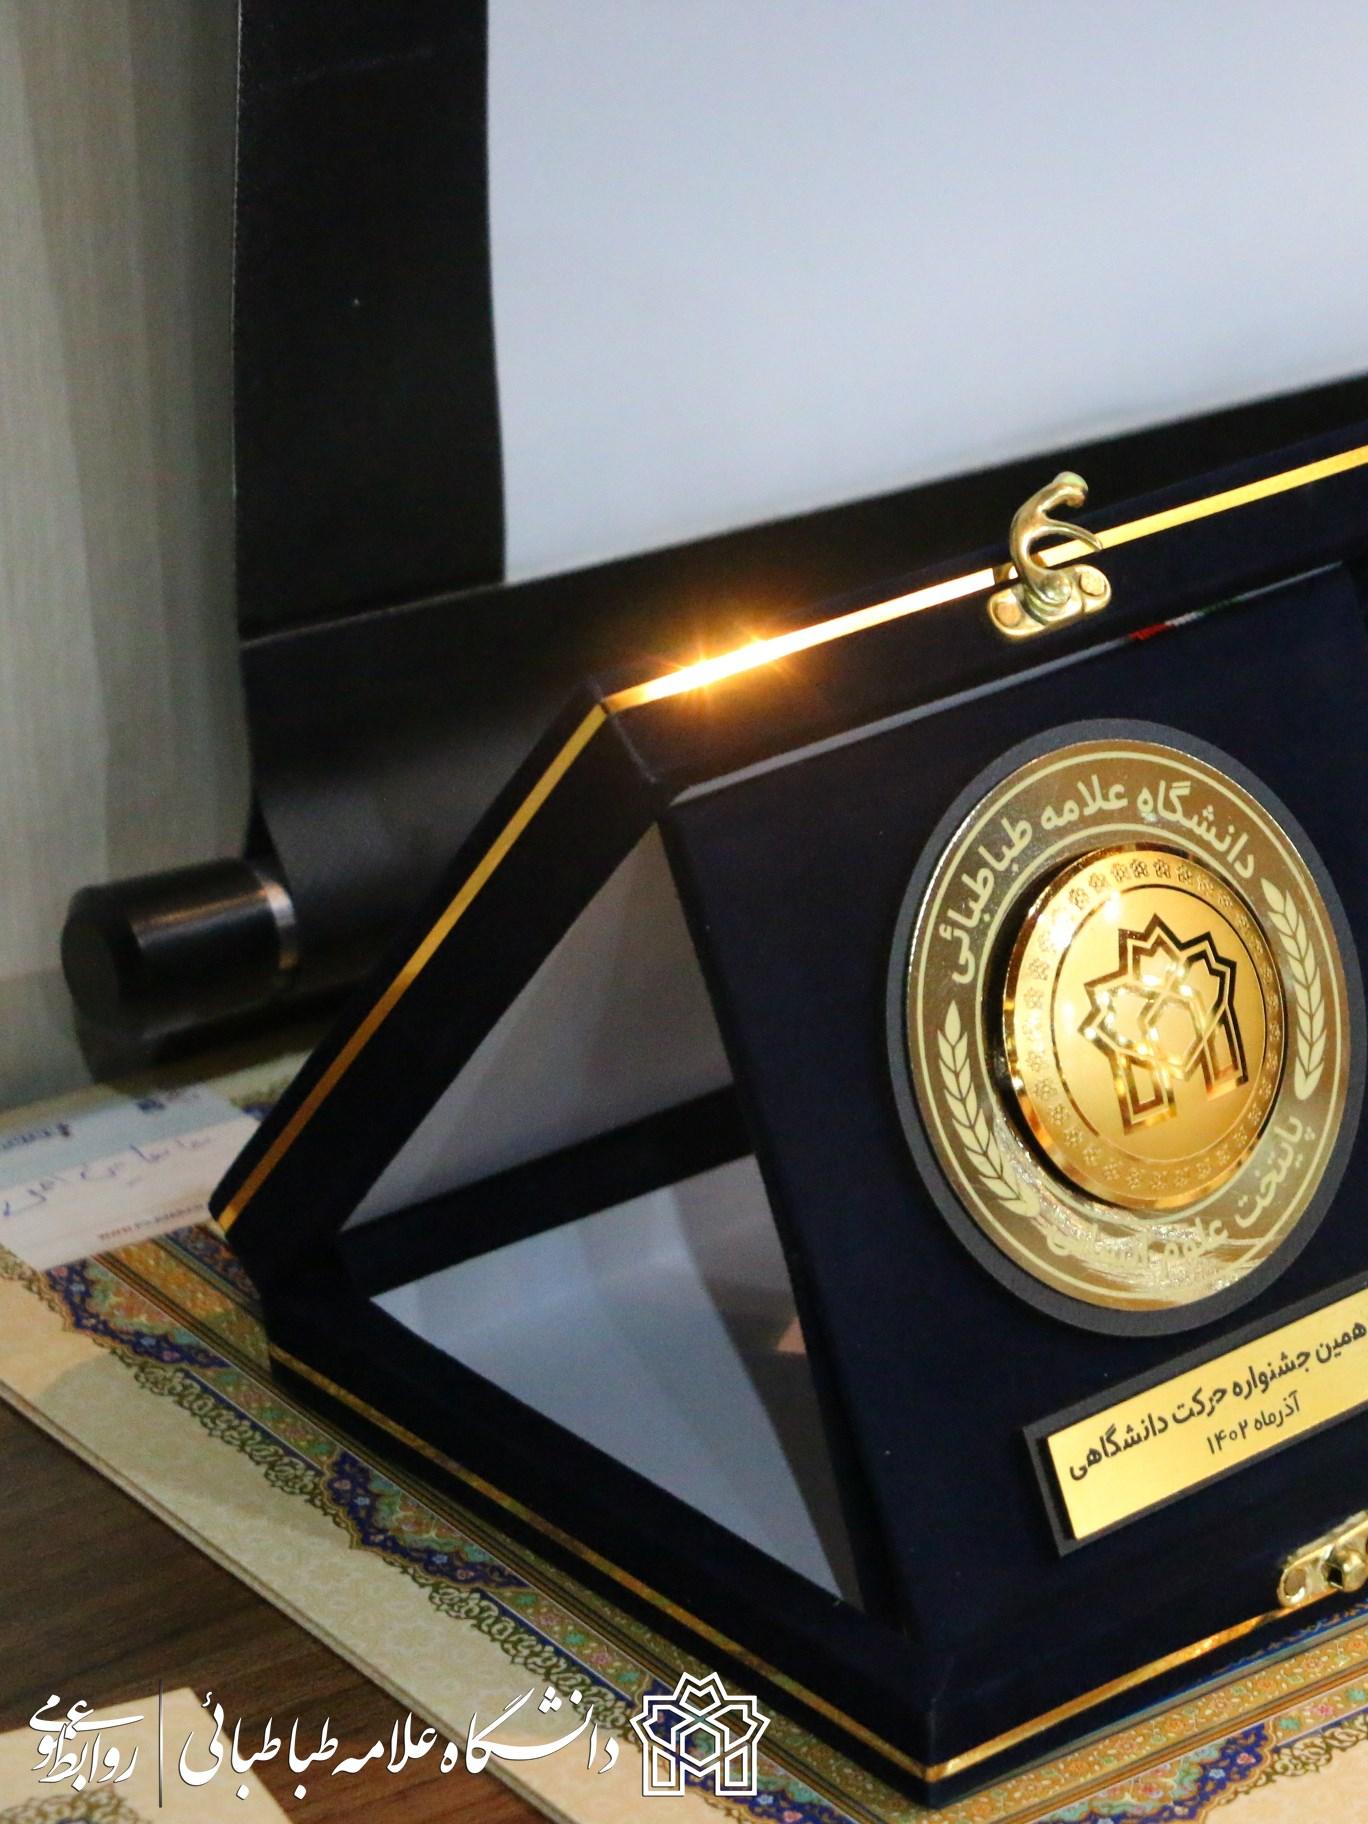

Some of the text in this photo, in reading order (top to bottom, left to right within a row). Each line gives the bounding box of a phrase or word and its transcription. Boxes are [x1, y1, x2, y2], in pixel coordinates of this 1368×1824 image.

[939, 774, 1255, 984] دانشگاه علامه طباطبائی
[1234, 1115, 1316, 1229] پایتخت
[1233, 1351, 1311, 1400] جشنواره
[1172, 1386, 1228, 1424] حرکت
[1069, 1413, 1169, 1481] دانشگاهی
[1206, 1419, 1249, 1455] ۱۴۰۲
